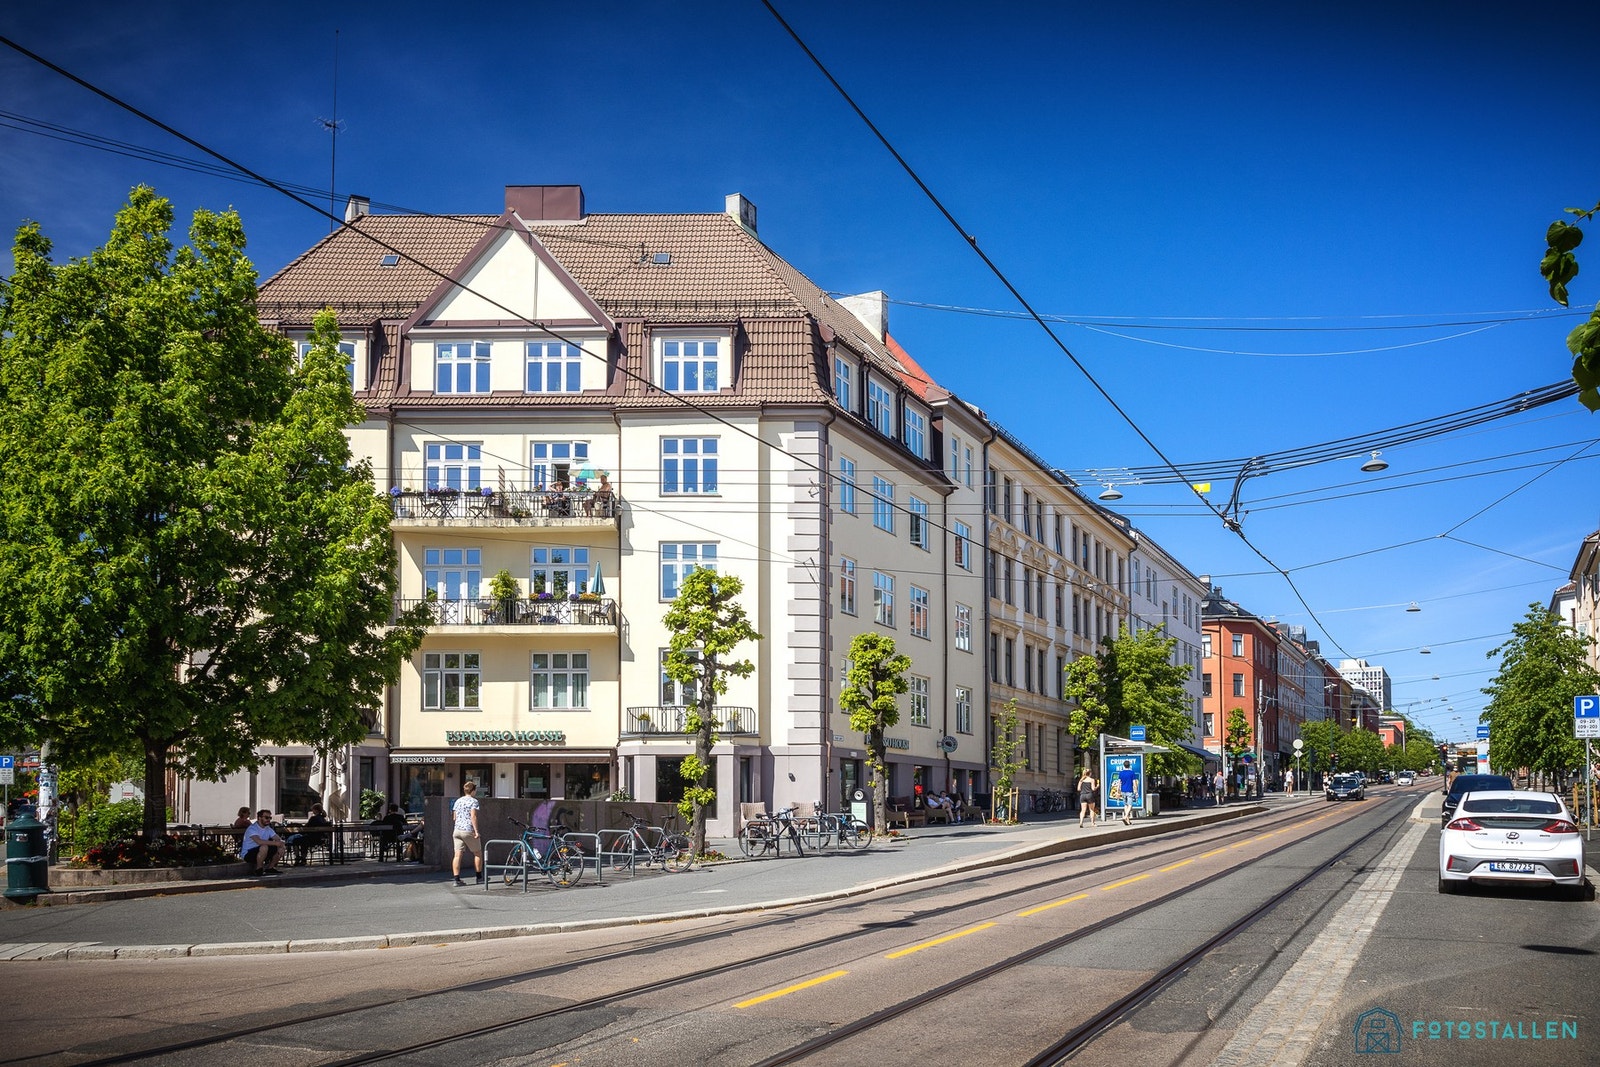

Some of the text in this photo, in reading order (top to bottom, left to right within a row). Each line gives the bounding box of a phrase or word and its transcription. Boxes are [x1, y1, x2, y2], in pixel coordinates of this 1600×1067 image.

[1580, 698, 1594, 716] P
[446, 730, 562, 742] ESPRESSO HOUSE
[2, 758, 10, 767] P
